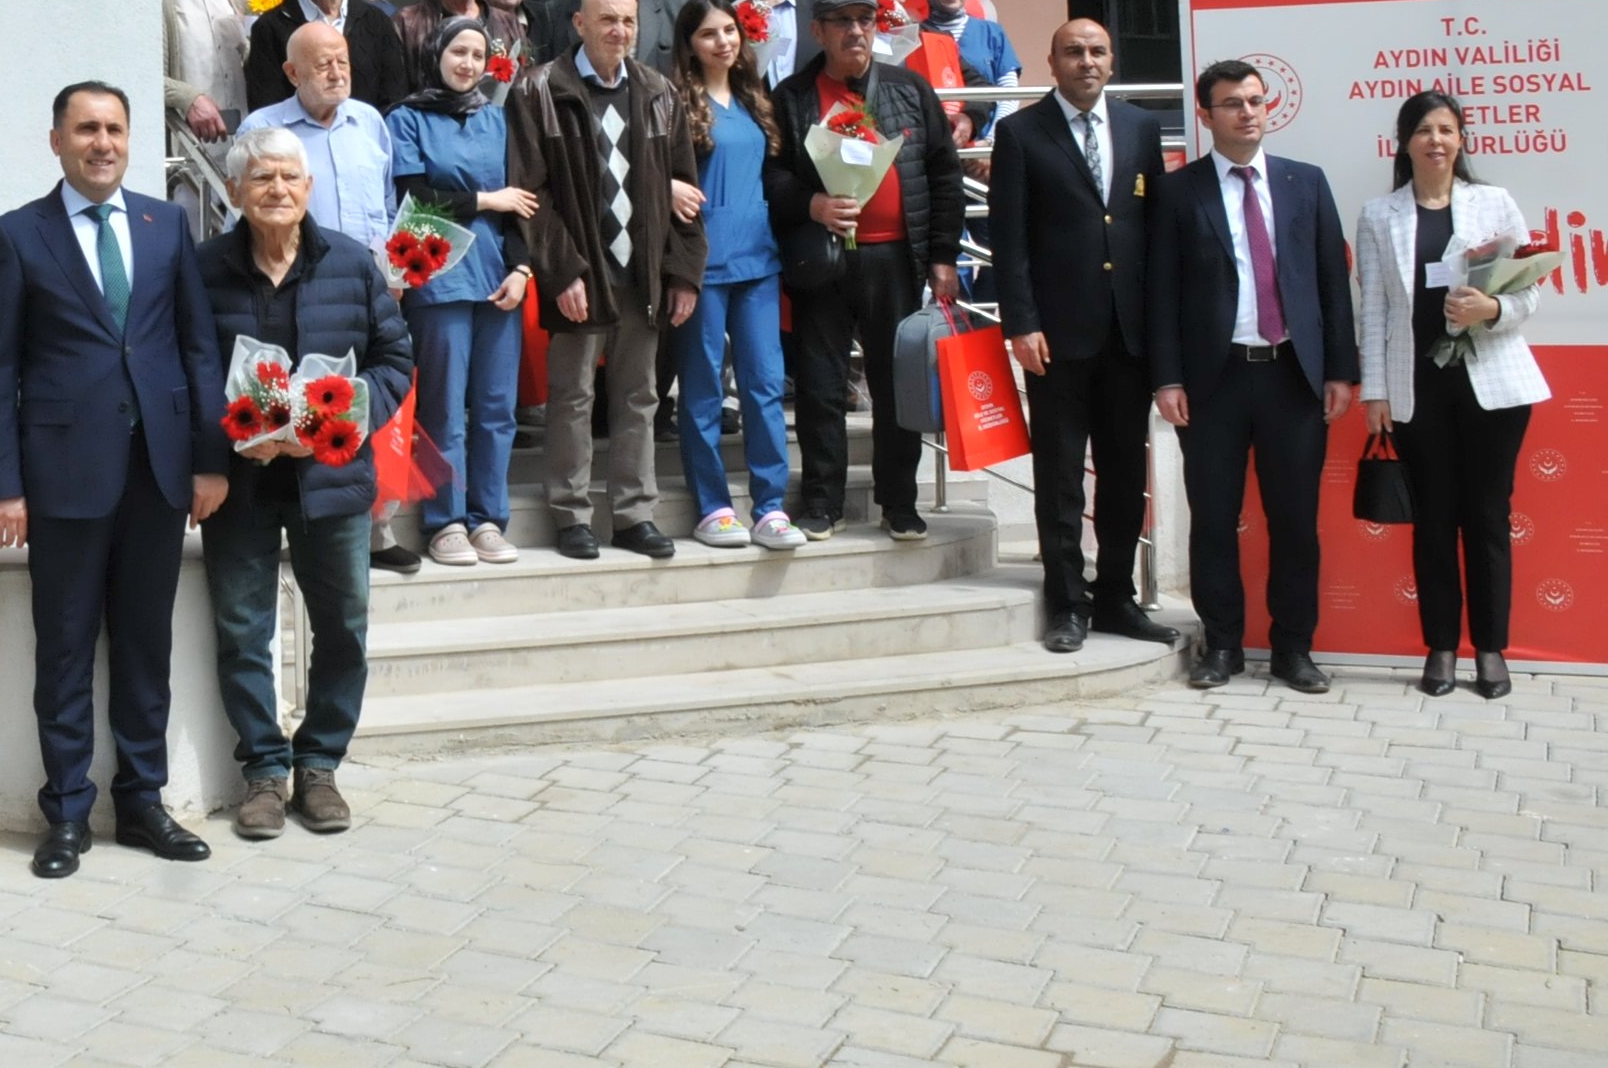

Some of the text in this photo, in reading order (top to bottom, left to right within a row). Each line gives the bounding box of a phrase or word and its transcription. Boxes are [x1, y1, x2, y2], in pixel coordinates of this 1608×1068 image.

[1441, 17, 1487, 36] T.C.
[1374, 38, 1560, 69] AYDIN VALİLİĞİ
[1349, 72, 1591, 99] AYDIN AİLE SOSYAL
[1462, 104, 1541, 125] ETLER
[1463, 129, 1567, 155] ÜRLÜĞÜ
